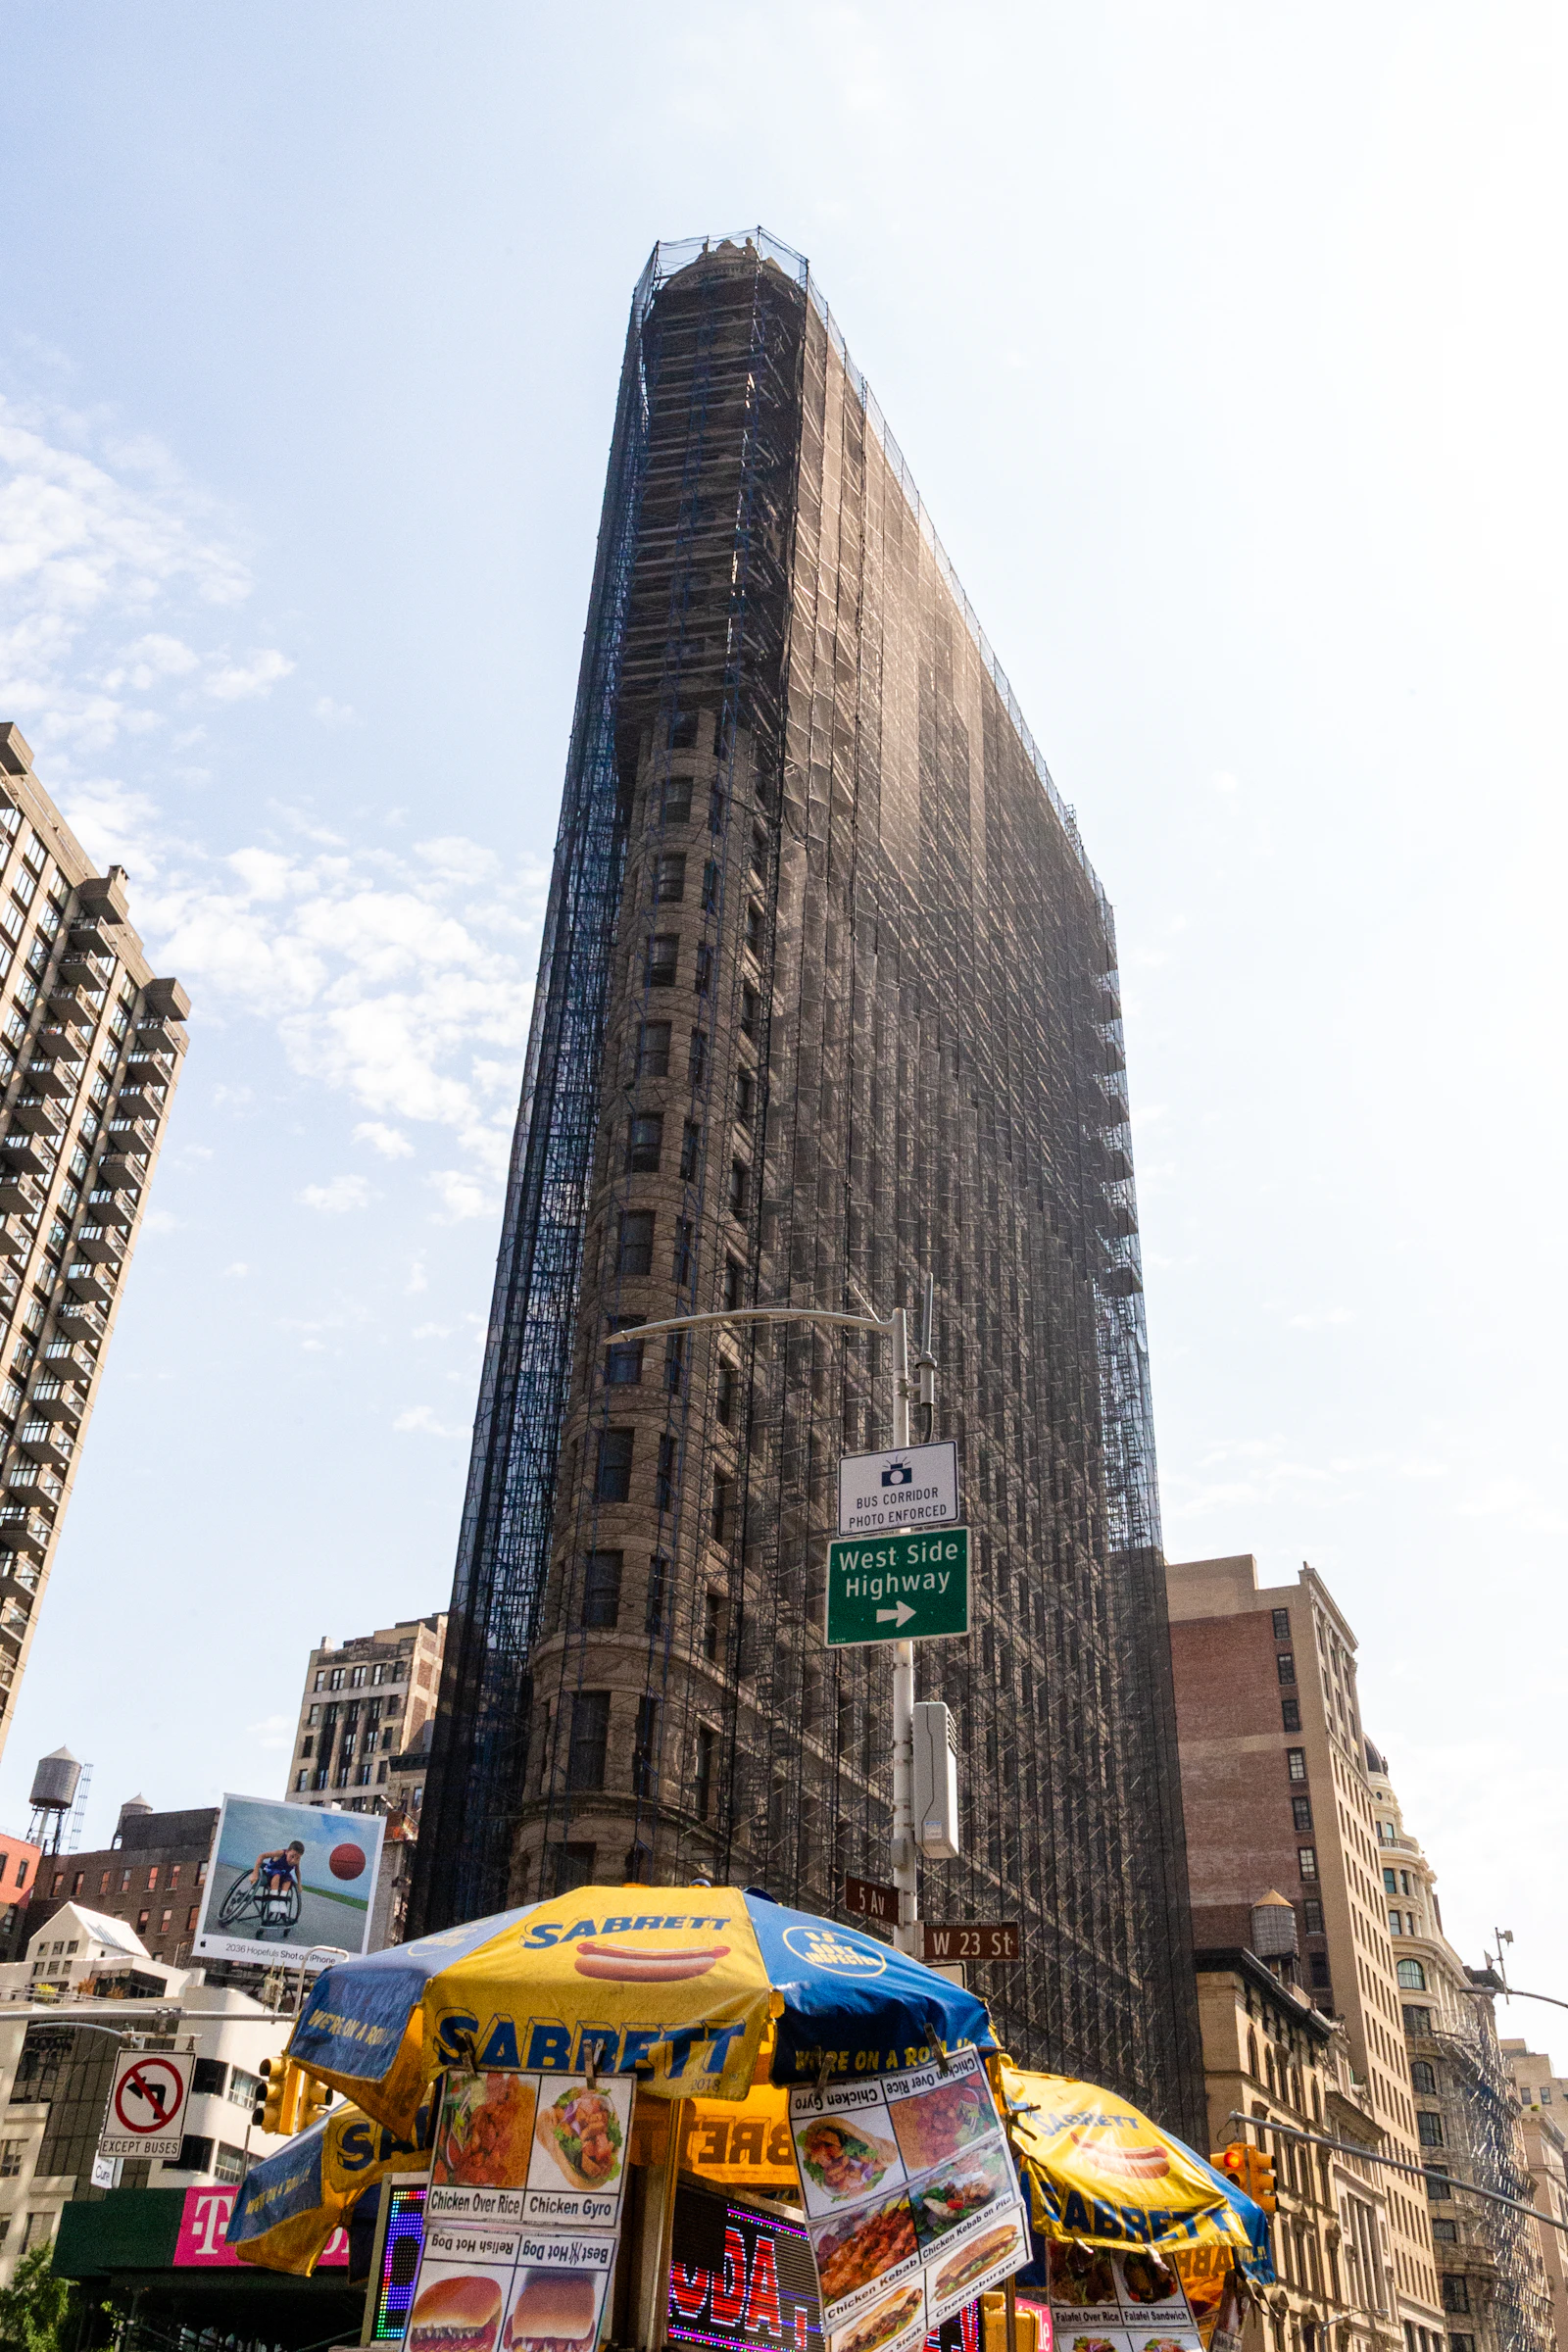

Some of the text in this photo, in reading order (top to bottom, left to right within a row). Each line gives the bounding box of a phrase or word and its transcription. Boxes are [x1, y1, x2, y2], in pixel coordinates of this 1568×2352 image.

[857, 1487, 939, 1509] BUS CORRIDOR
[849, 1514, 884, 1529] PHOTO
[888, 1504, 947, 1523] ENFORCED
[839, 1541, 958, 1571] West Side
[846, 1570, 951, 1600] Highway
[858, 1886, 866, 1910] 5
[519, 1915, 731, 1949] SABRETT
[225, 1942, 245, 1953] 2036
[247, 1946, 278, 1958] Hopefuls
[280, 1950, 298, 1960] Shot
[309, 1953, 336, 1965] iPhone
[933, 1932, 1011, 1956] W 23 St
[433, 2007, 747, 2081] SABRETT
[795, 2050, 850, 2072] WRE
[855, 2050, 879, 2071] ON
[886, 2050, 898, 2070] A
[905, 2040, 948, 2067] ROL
[886, 2080, 909, 2095] Rice
[911, 2073, 935, 2089] Over
[795, 2088, 878, 2111] Chicken Gyro
[1031, 2110, 1140, 2137] SABRETT
[102, 2140, 178, 2154] EXCEPT BUSES
[95, 2165, 110, 2181] Cure
[431, 2190, 520, 2215] Chicken Over Rice
[529, 2195, 612, 2219] Chicken Gyro
[923, 2195, 1012, 2259] Chicken Kebab on Pita
[431, 2233, 514, 2255] Relish Hot Dog
[522, 2239, 545, 2260] Dog
[550, 2244, 569, 2262] Hot
[582, 2247, 610, 2264] Best
[827, 2258, 917, 2320] Chicken Kebab
[935, 2259, 1018, 2318] Cheeseburger
[1055, 2311, 1120, 2323] Falafel Over Rice
[1124, 2311, 1188, 2323] Falafel Sandwich
[896, 2328, 921, 2350] Steak
